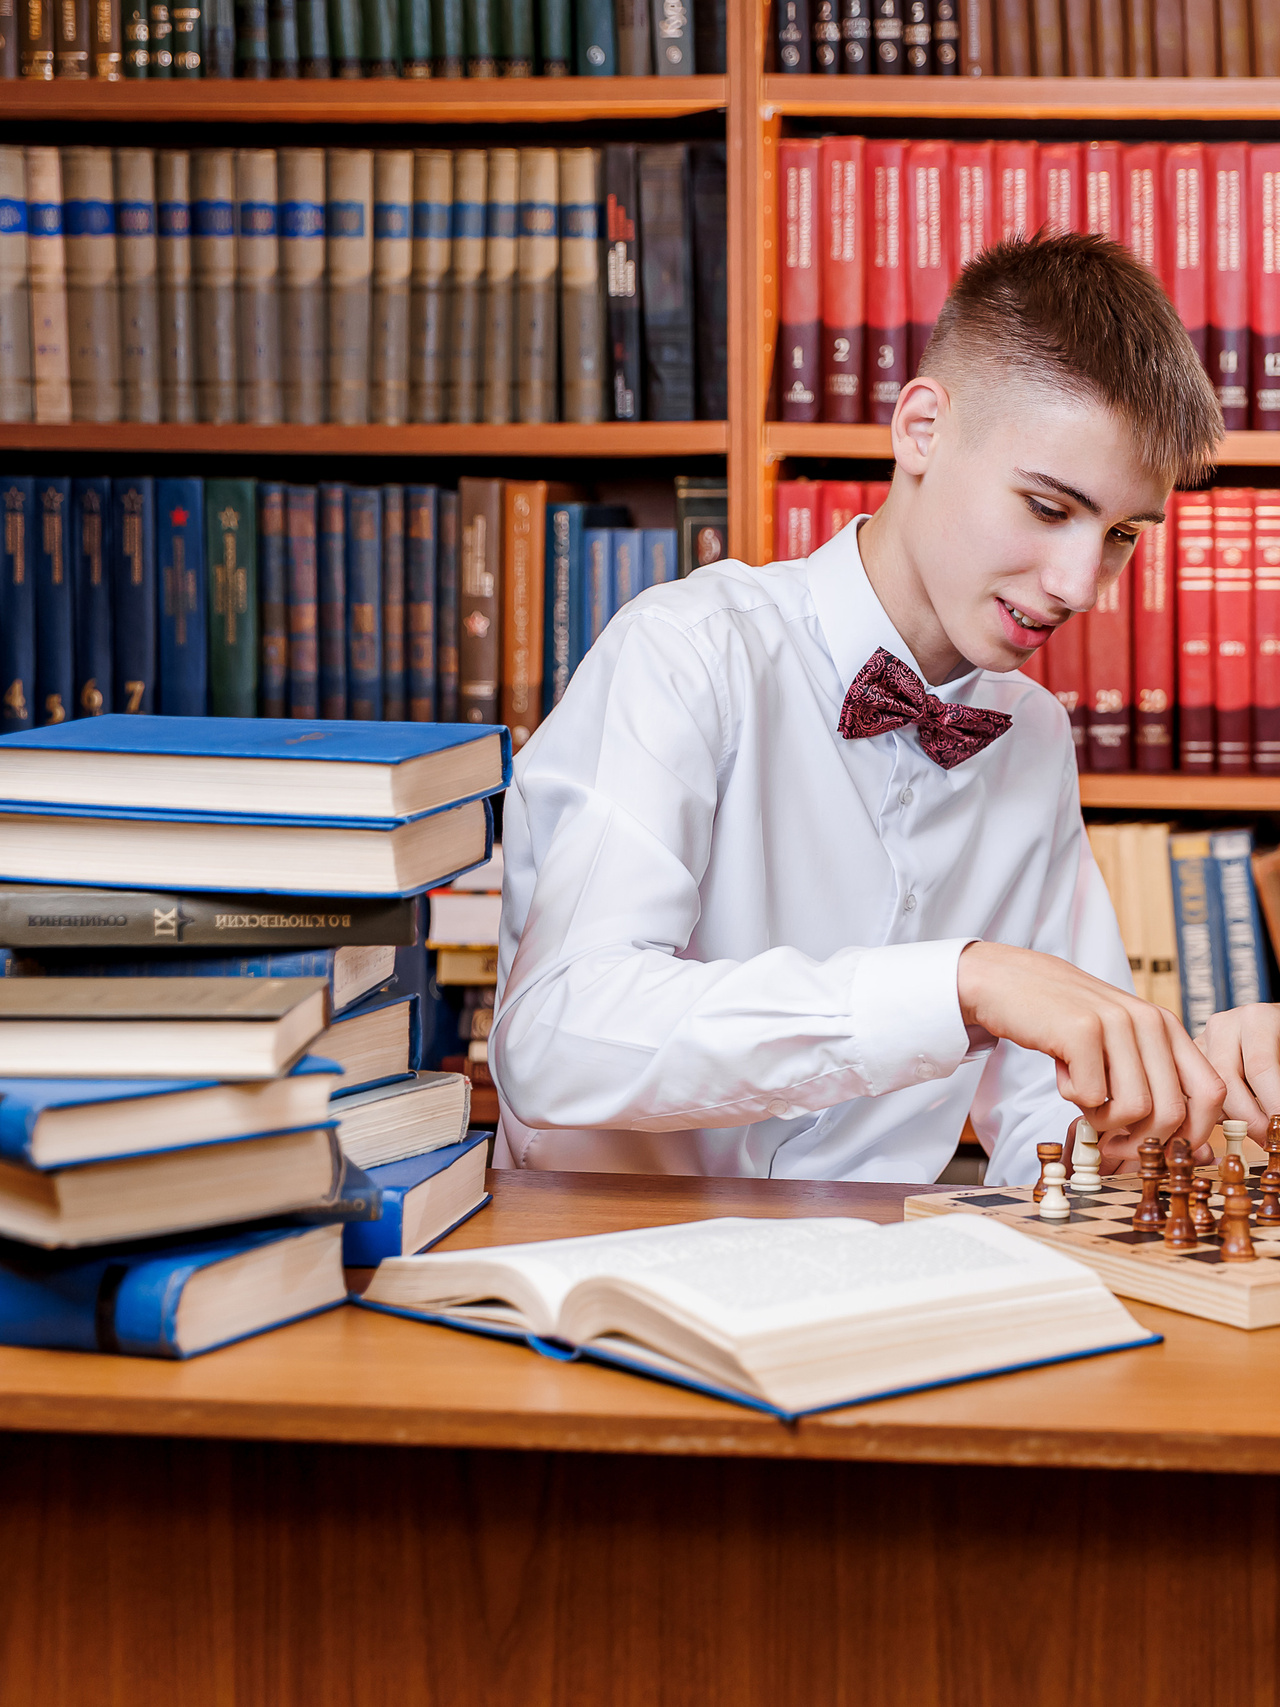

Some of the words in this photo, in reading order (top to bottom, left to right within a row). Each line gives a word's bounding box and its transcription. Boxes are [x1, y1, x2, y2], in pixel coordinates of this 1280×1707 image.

[792, 346, 804, 369] 1
[833, 337, 850, 362] 2
[877, 344, 895, 369] 3
[1219, 350, 1237, 373] 11
[81, 678, 103, 712] 6
[125, 681, 145, 712] 7
[27, 914, 127, 927] СОЧИНЕНИЯ
[154, 907, 176, 936] IX
[215, 914, 325, 930] КЛЮЧЕВСКИЙ
